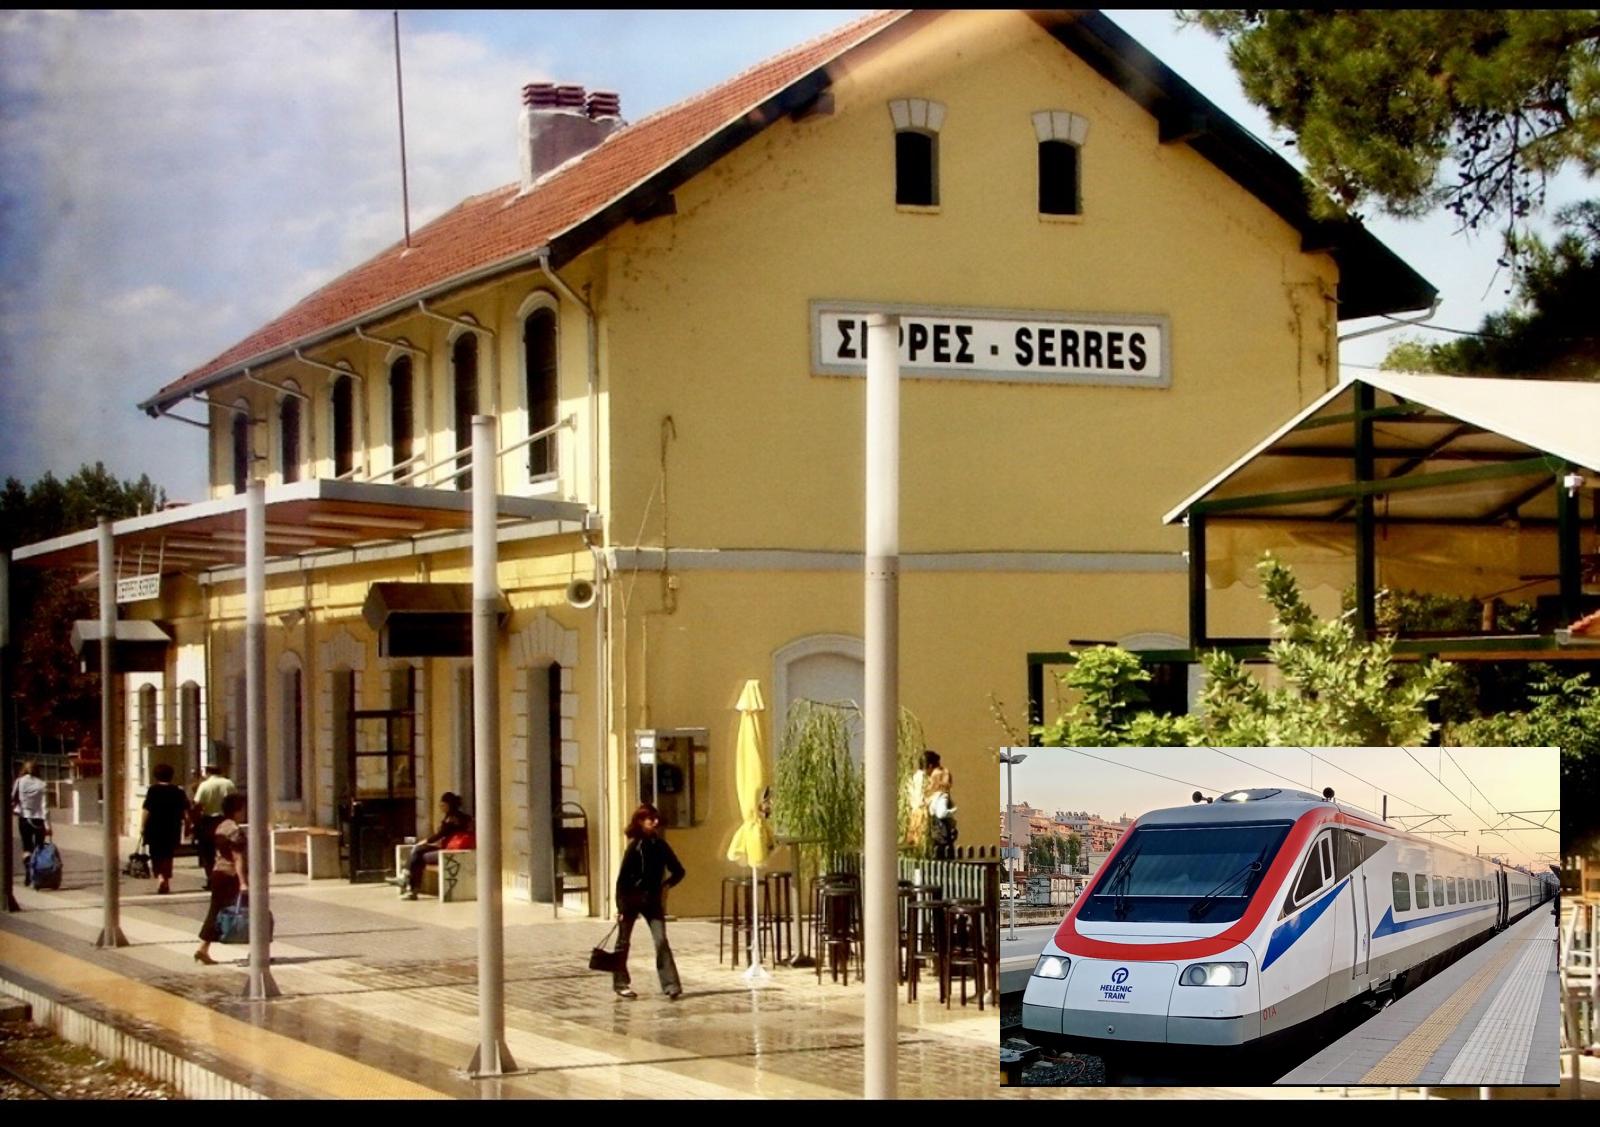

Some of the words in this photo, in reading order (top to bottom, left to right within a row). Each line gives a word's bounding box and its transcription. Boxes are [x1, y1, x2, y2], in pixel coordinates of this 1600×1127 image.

[837, 319, 974, 363] ΣΡΕΣ
[1015, 326, 1147, 371] SERRES
[1100, 984, 1133, 993] HELLENIC
[1104, 992, 1126, 1000] TRAIN
